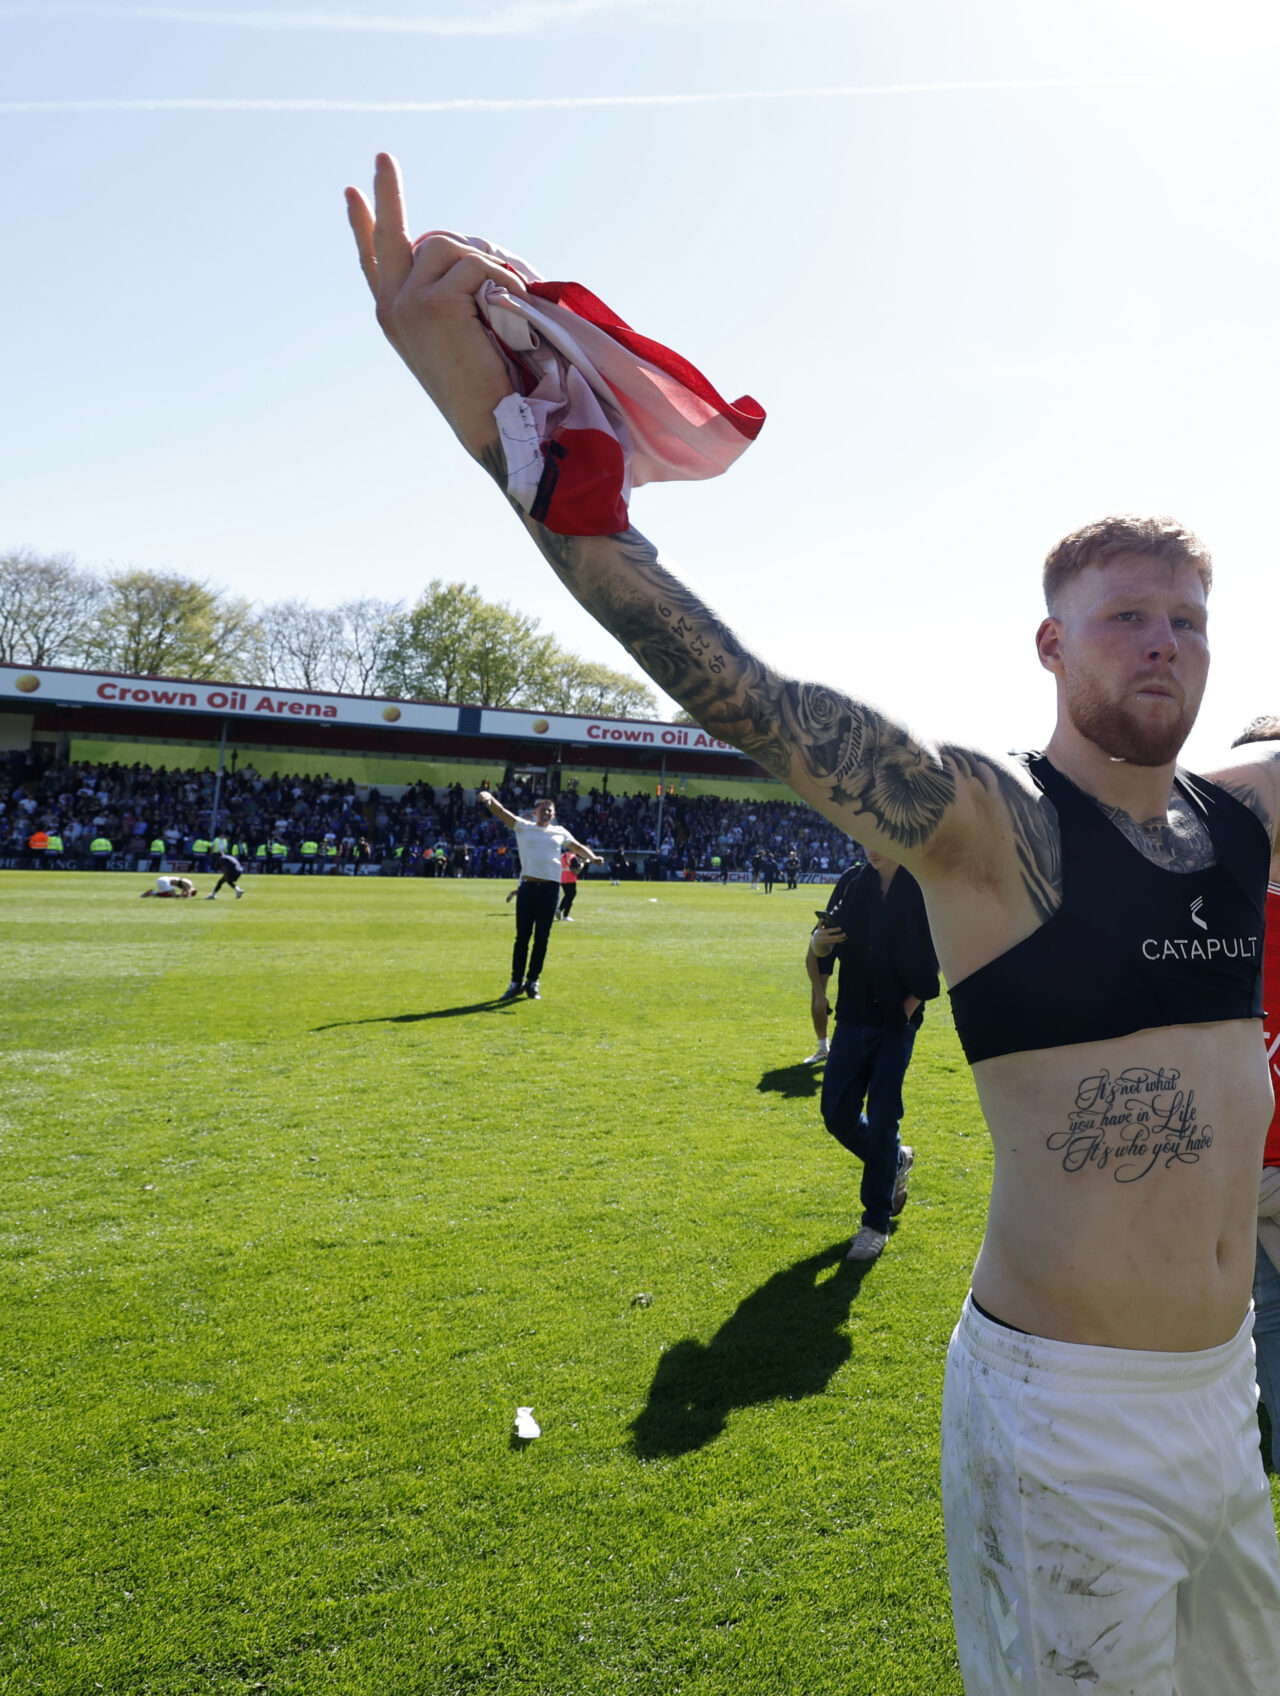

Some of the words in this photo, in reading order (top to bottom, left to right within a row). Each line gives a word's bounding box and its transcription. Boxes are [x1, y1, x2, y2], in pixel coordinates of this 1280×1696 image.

[671, 616, 693, 638] 24
[689, 634, 710, 656] 25
[708, 654, 726, 674] 49
[97, 682, 197, 707] Crown
[207, 691, 247, 710] Oil
[254, 696, 338, 718] Arena
[586, 724, 655, 743] Crown
[661, 730, 688, 746] Oil
[1142, 937, 1257, 960] CATAPULT
[1145, 1067, 1181, 1093] what
[1099, 1104, 1133, 1128] have
[1136, 1107, 1151, 1123] in
[1151, 1089, 1197, 1136] Life
[1115, 1126, 1151, 1157] who
[1184, 1124, 1214, 1152] have
